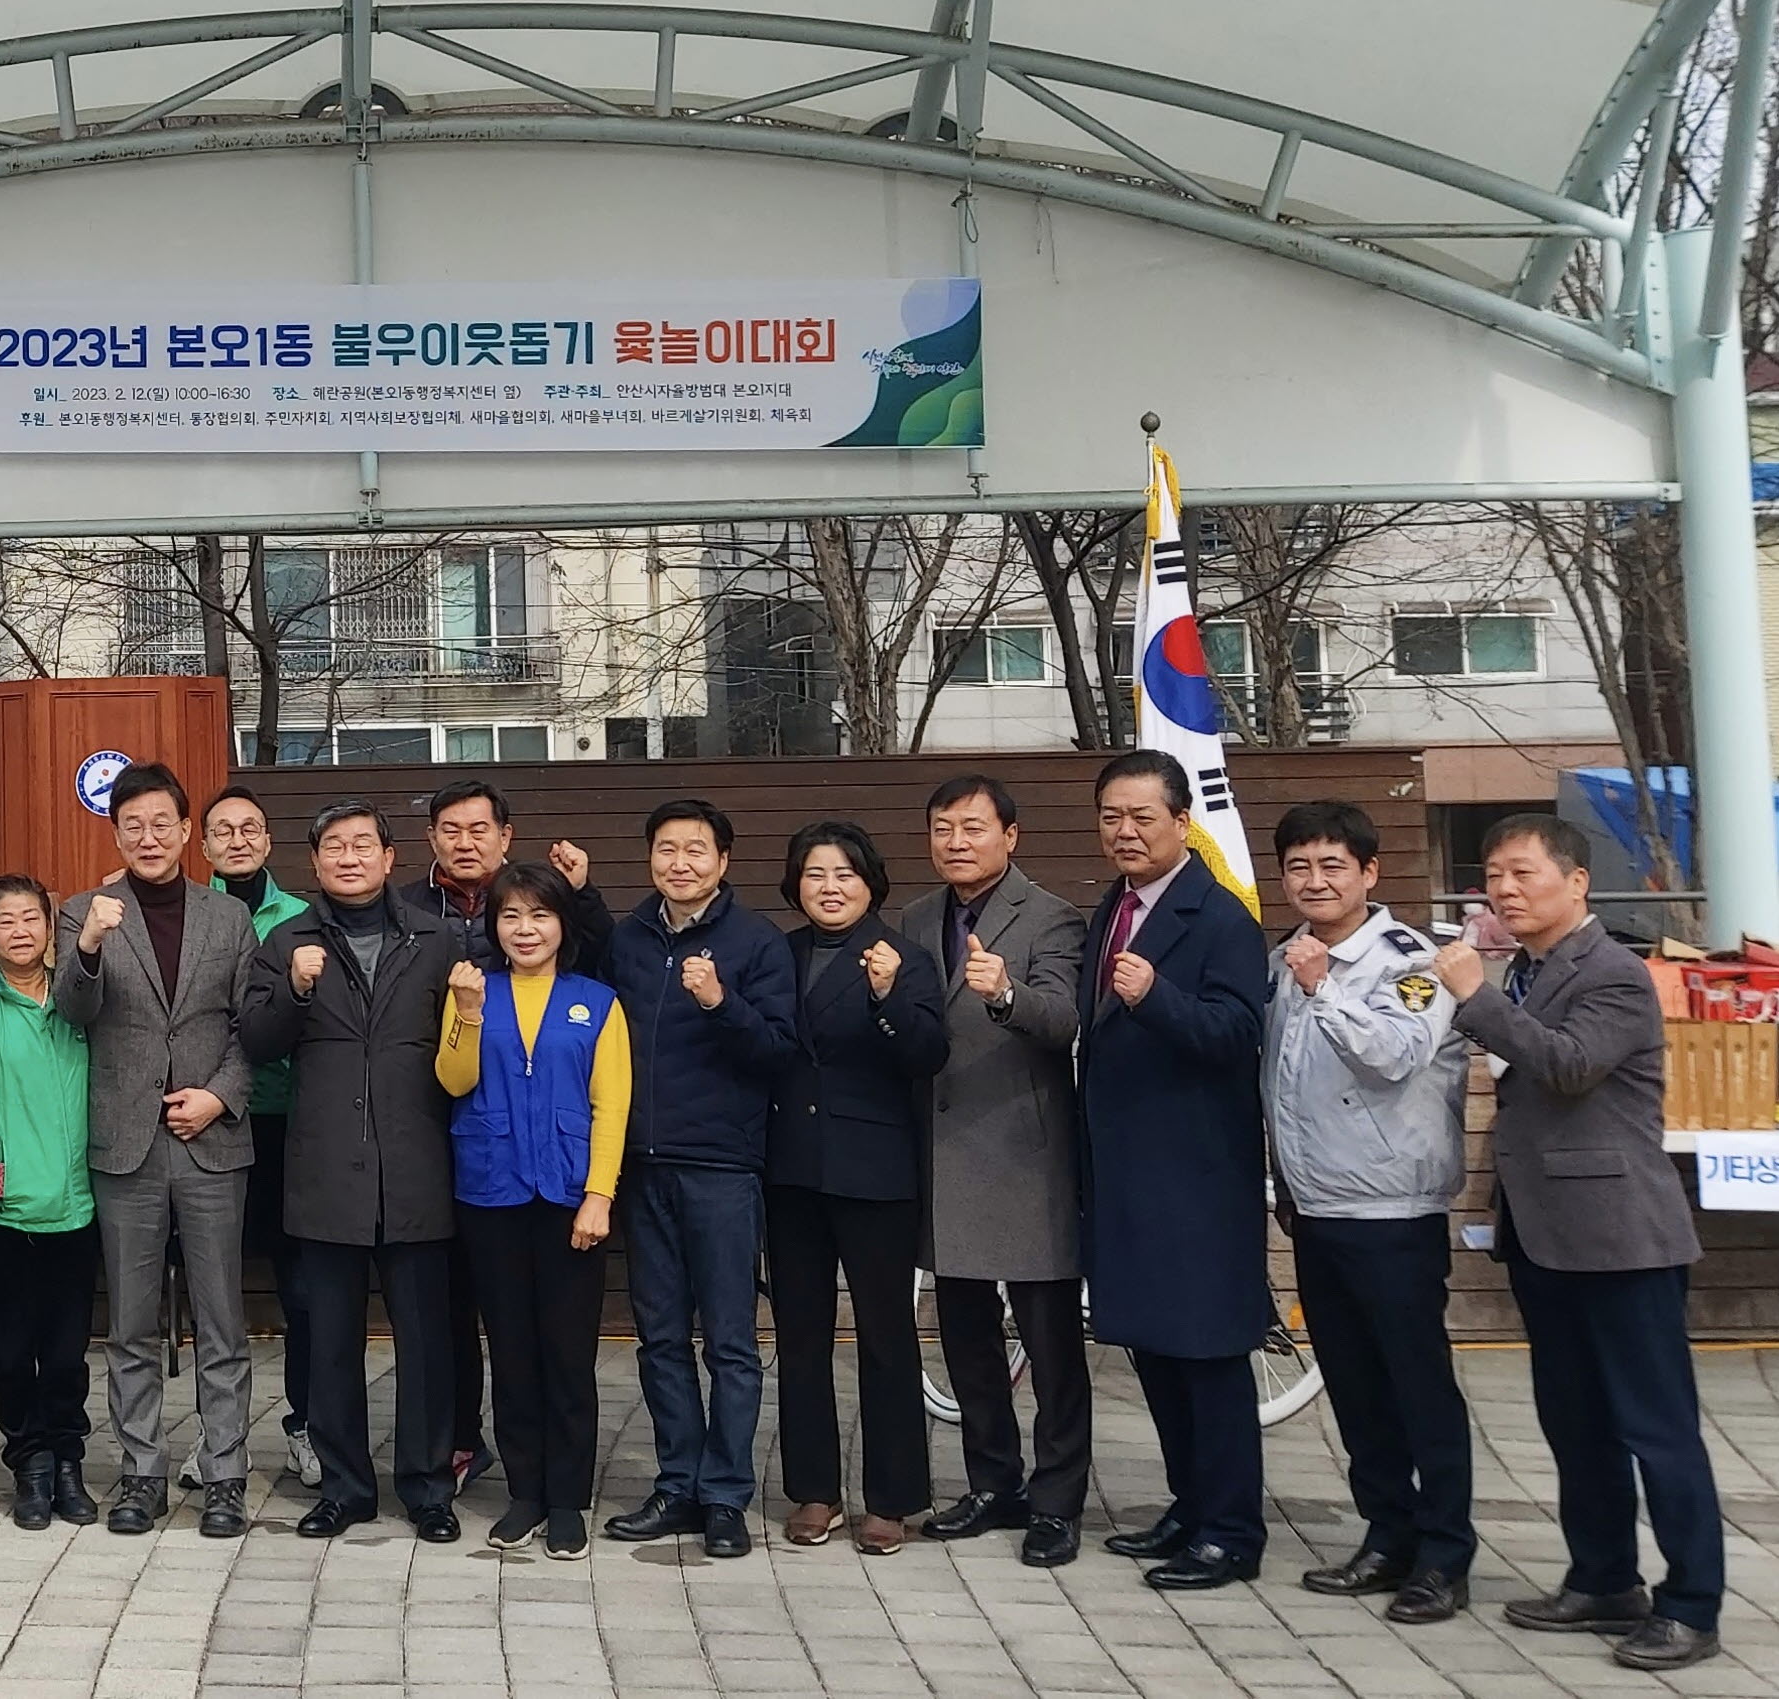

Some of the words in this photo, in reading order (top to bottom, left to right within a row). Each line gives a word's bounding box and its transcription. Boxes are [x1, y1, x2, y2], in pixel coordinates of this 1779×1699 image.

[167, 323, 314, 368] 본오1동
[331, 320, 594, 367] 불우이웃돕기
[613, 317, 836, 365] 윷놀이대회
[71, 387, 109, 401] 2023.
[616, 383, 727, 400] 안산시자율방범대
[731, 382, 792, 399] 본오1지대
[770, 407, 812, 424] 체육회
